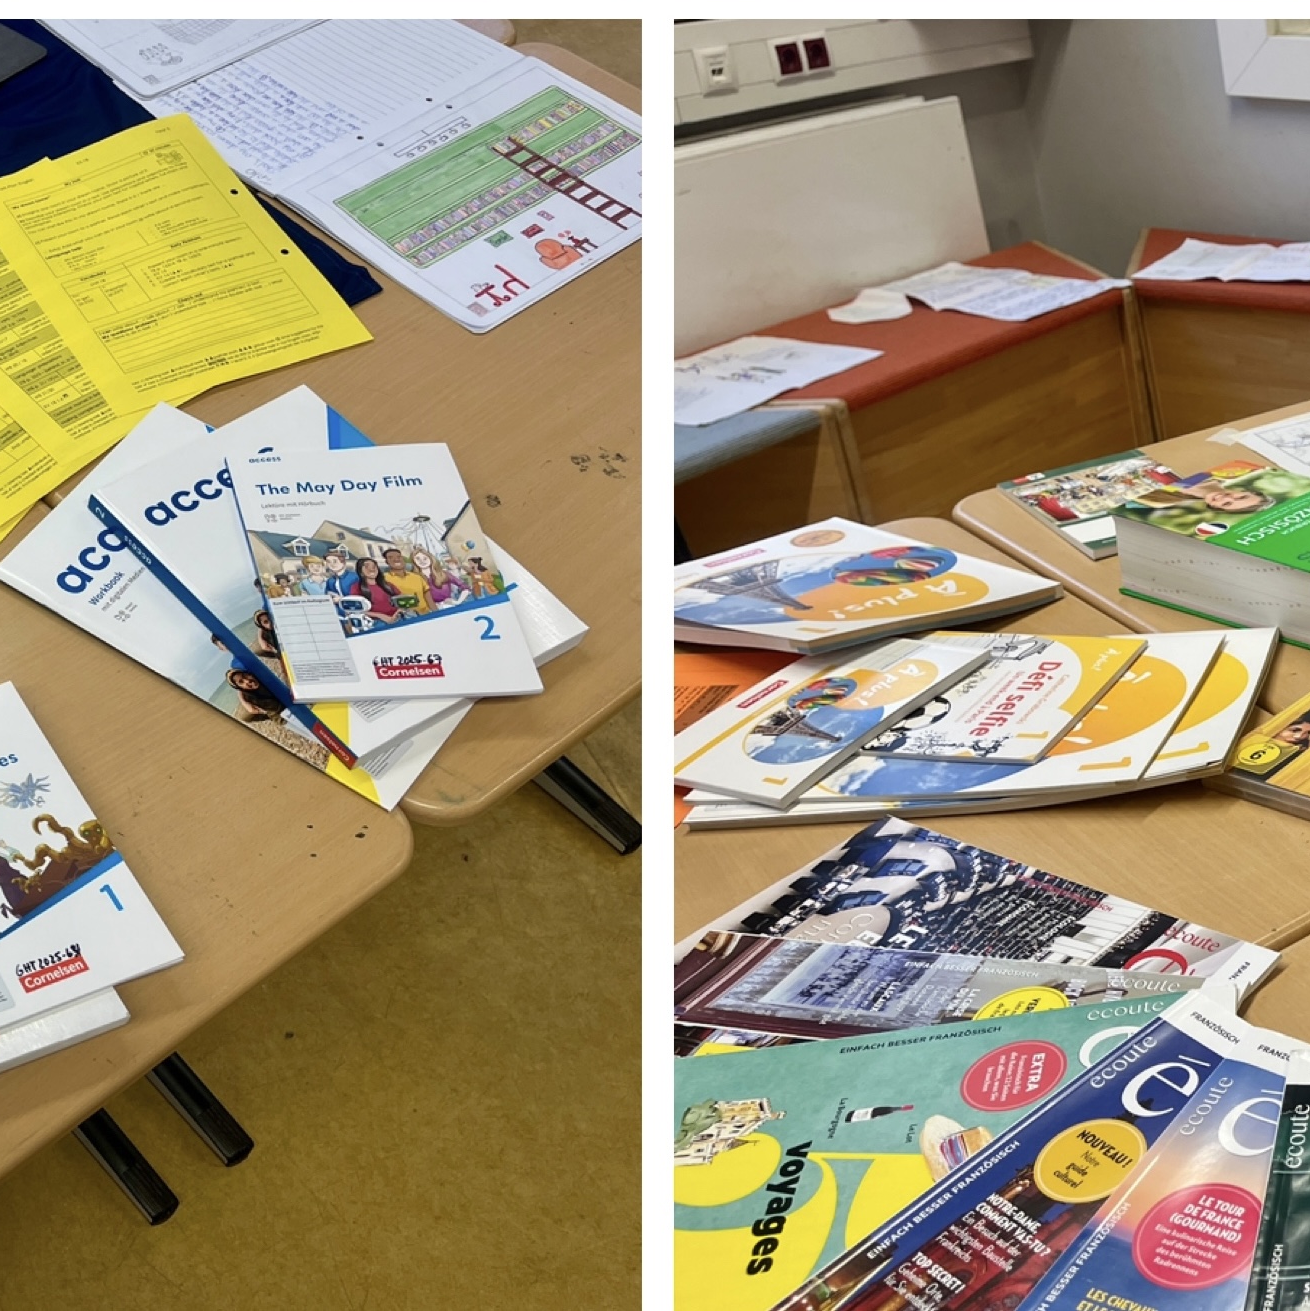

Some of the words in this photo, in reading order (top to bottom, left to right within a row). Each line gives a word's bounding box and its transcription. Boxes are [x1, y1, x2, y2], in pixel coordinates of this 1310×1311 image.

[255, 483, 291, 496] The
[296, 482, 336, 495] May
[340, 479, 378, 493] Day
[382, 475, 423, 488] Film
[88, 571, 125, 606] Workbook
[833, 587, 920, 619] plus!
[474, 615, 501, 640] 2
[379, 666, 440, 677] Cornelsen
[1027, 661, 1064, 693] Défi
[969, 693, 1018, 738] selfie
[99, 884, 124, 912] 1
[24, 960, 84, 989] Cornelsen
[839, 1043, 885, 1054] EINFACH
[887, 1036, 926, 1049] BESSER
[928, 1025, 1002, 1043] FRANZÖSISCH
[1190, 1010, 1240, 1044] FRANZÖSISCH
[1024, 1052, 1046, 1092] EXTRA
[1076, 1129, 1133, 1168] NOUVEAU!
[746, 1140, 812, 1276] voyages
[1183, 1204, 1203, 1217] DE
[1204, 1209, 1245, 1230] FRANCE
[1198, 1194, 1214, 1207] LE
[1215, 1198, 1246, 1217] TOUR
[1169, 1211, 1242, 1243] (GOURMAND)
